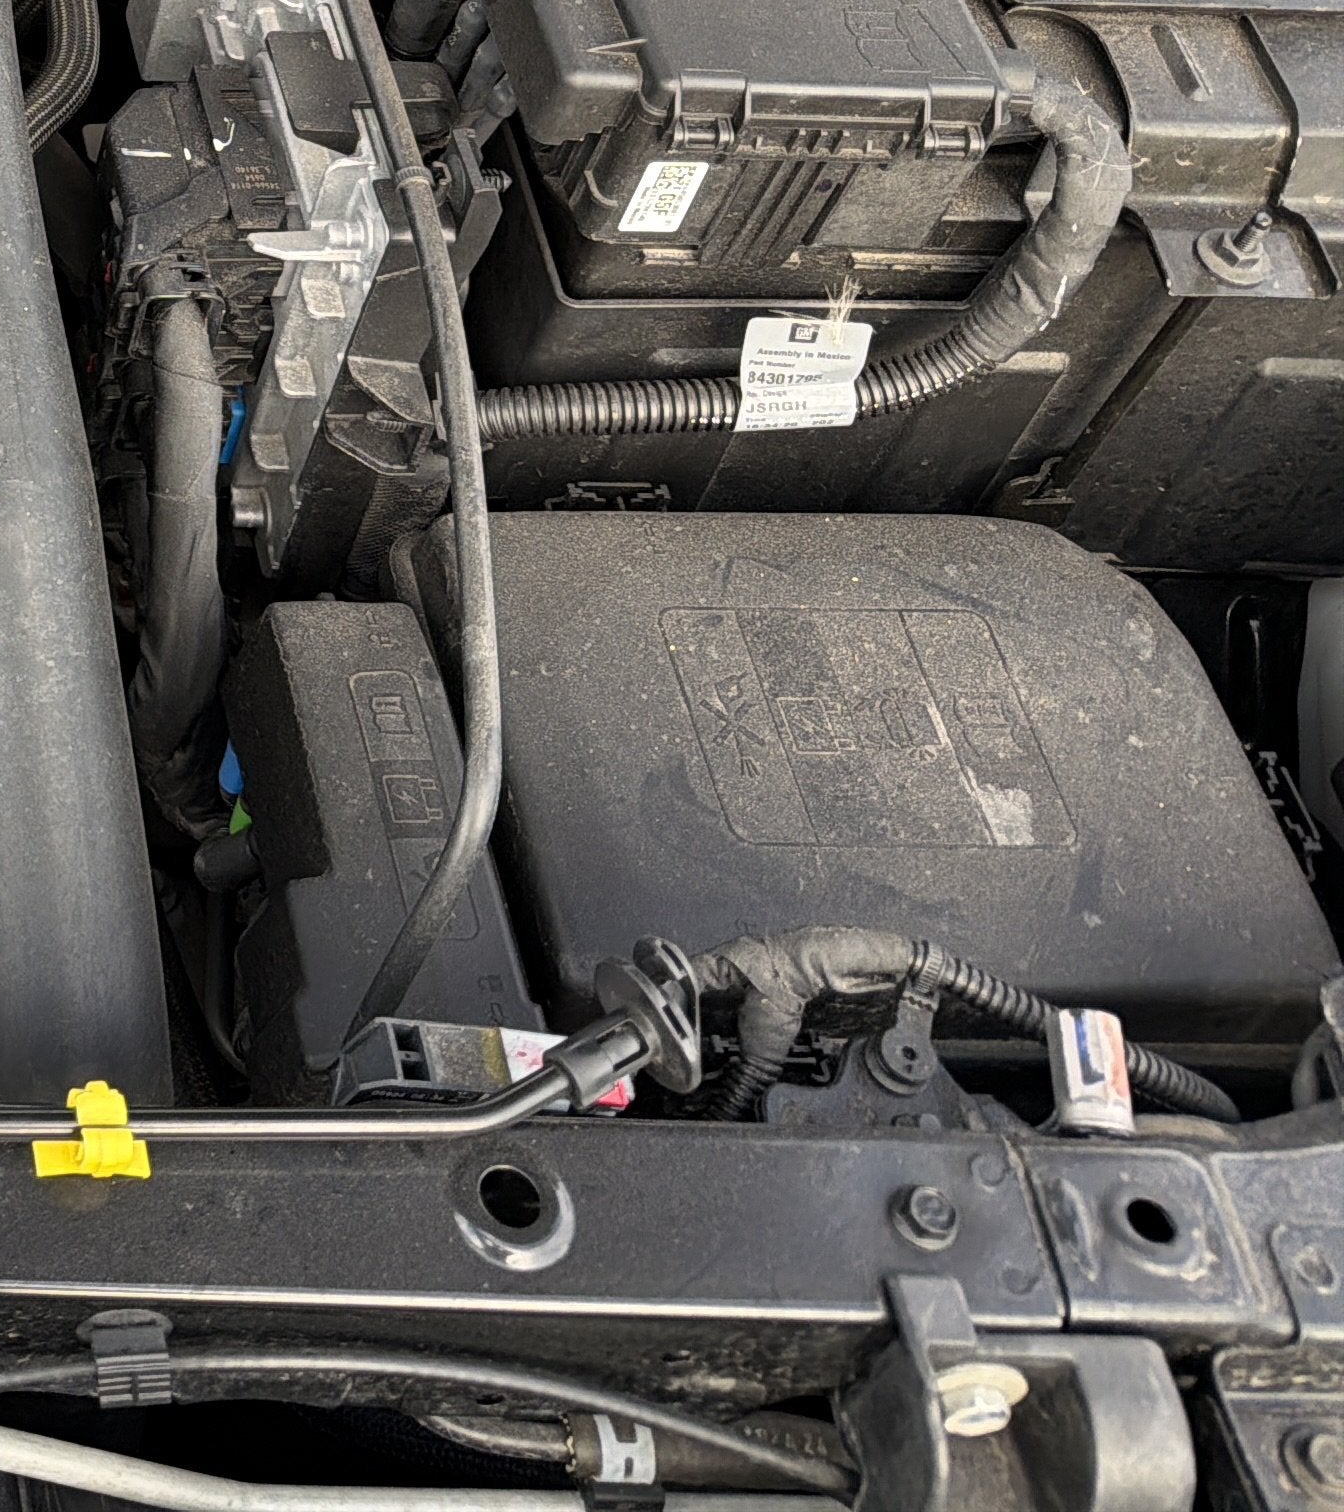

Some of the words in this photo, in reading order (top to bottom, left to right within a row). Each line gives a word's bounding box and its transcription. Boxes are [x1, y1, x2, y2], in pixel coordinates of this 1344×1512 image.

[757, 348, 802, 359] Assembly
[804, 350, 814, 358] in
[817, 352, 852, 360] Mexico
